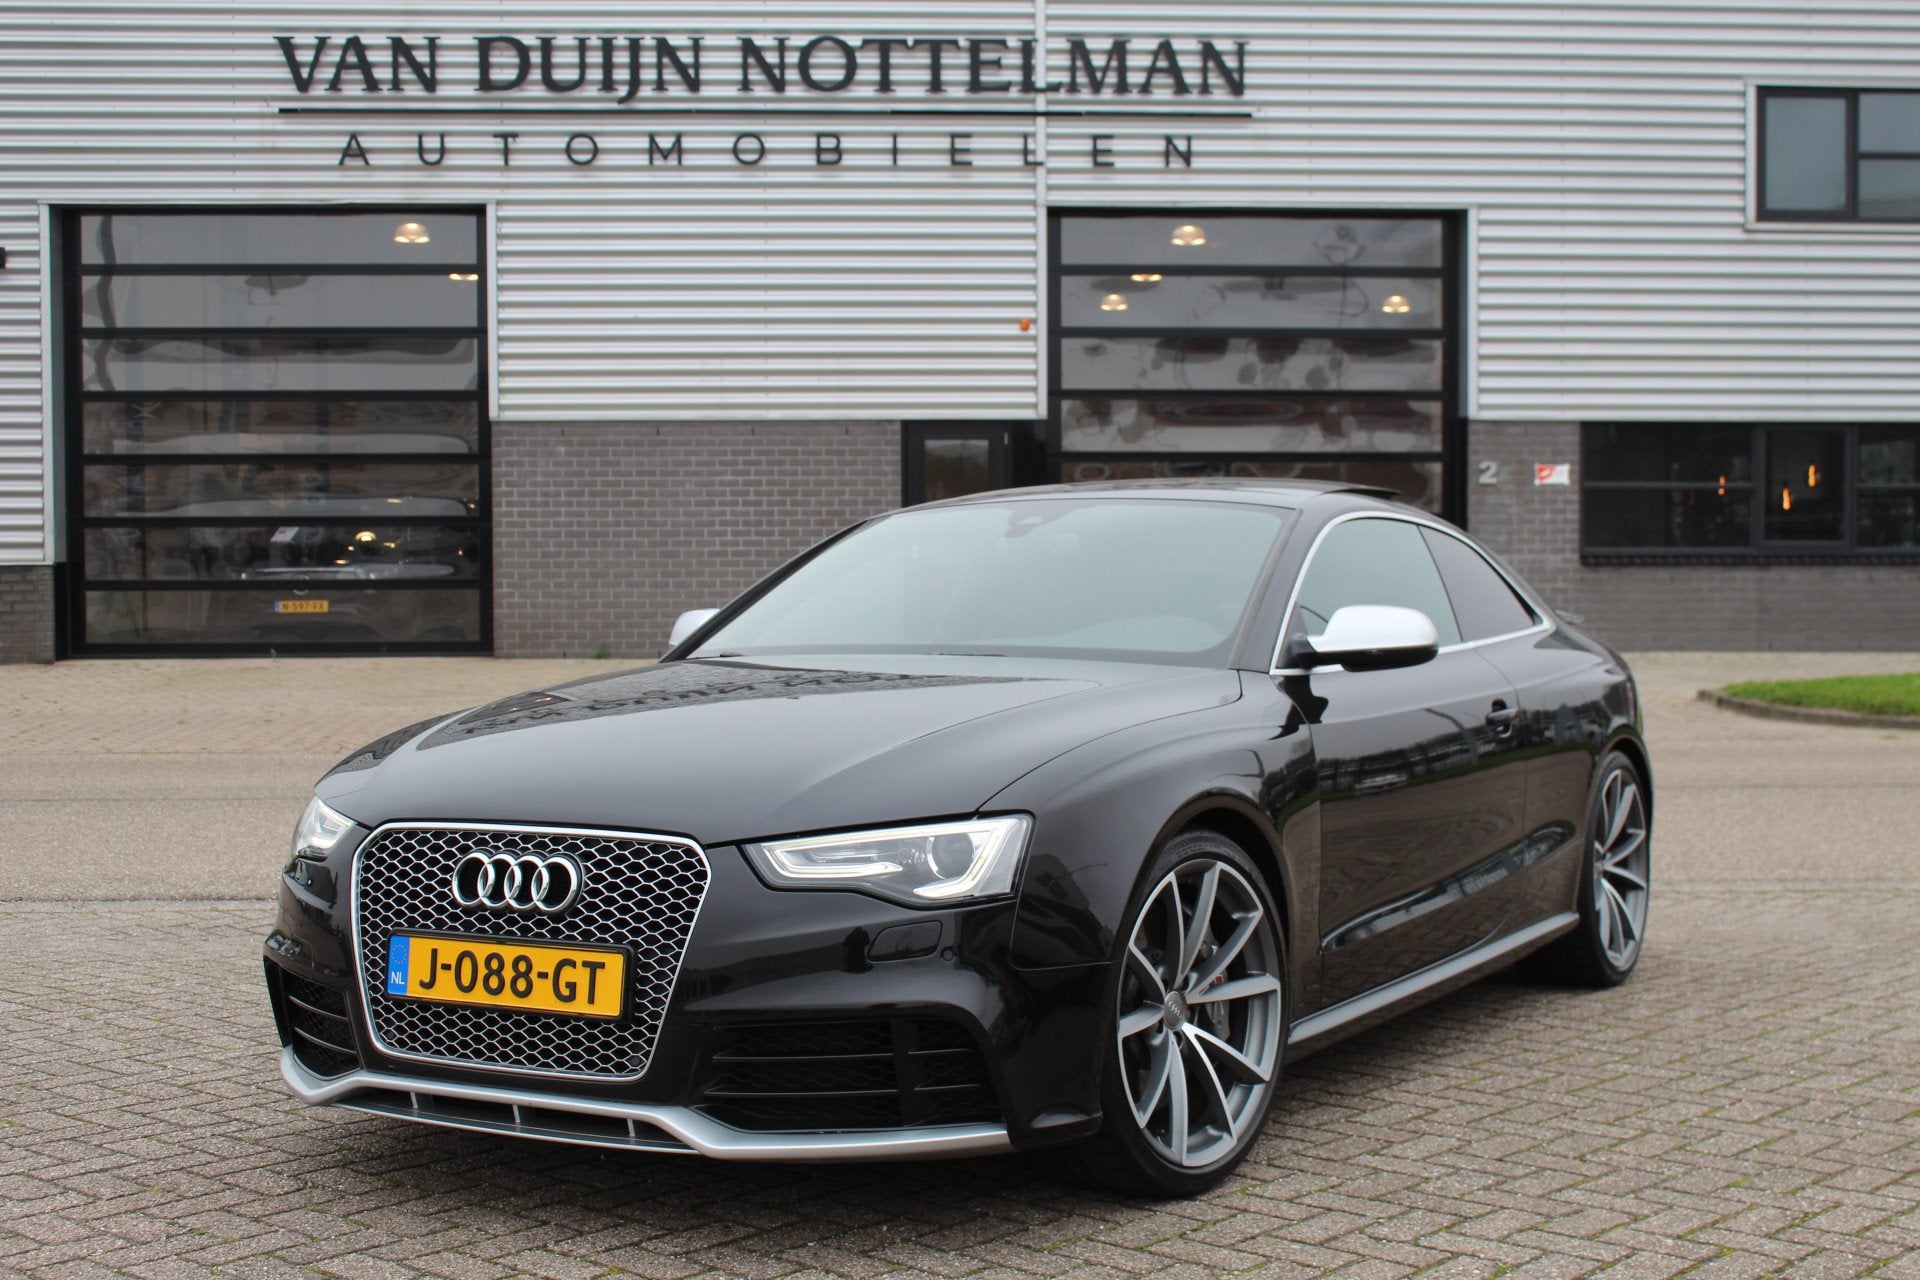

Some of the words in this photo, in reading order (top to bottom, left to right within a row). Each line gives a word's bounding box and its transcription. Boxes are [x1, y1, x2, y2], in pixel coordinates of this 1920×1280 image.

[274, 36, 440, 93] VAN
[473, 36, 704, 104] DUIJN
[737, 36, 1249, 96] NOTTELMAN
[338, 132, 1193, 167] AUTOMOBIELEN
[1478, 461, 1498, 485] 2
[391, 971, 405, 985] NL
[419, 948, 606, 1004] J-088-GT
